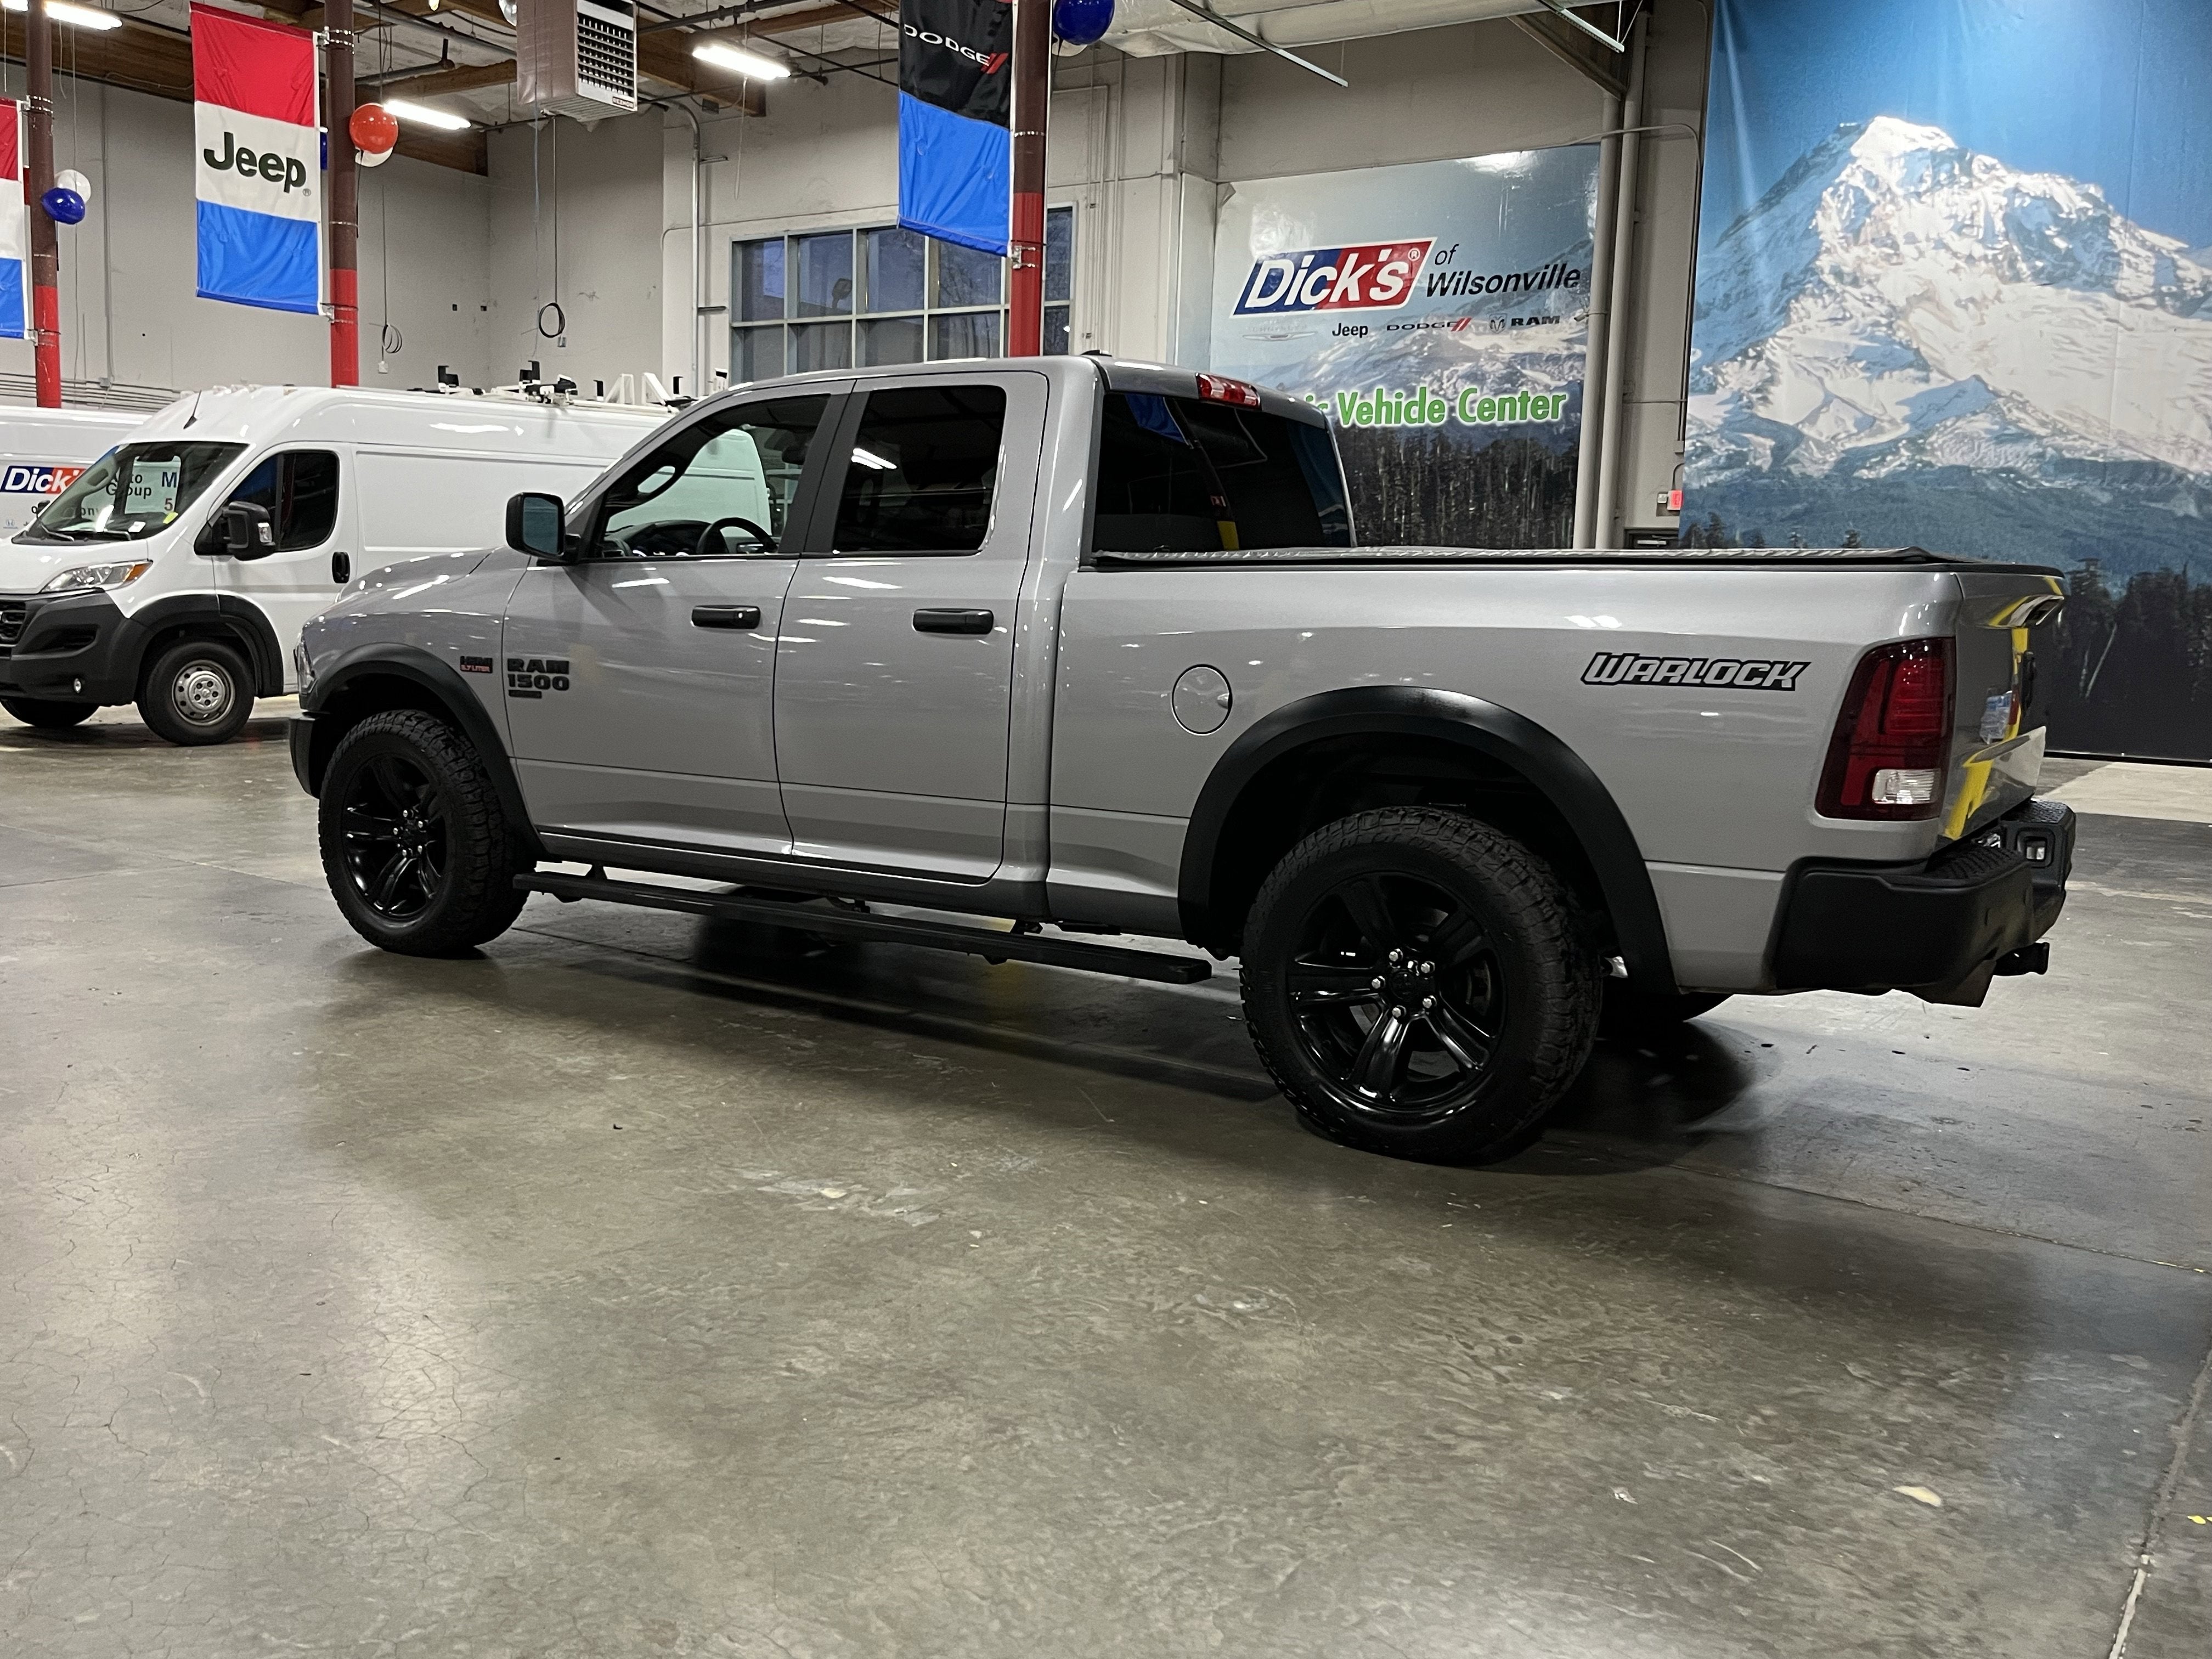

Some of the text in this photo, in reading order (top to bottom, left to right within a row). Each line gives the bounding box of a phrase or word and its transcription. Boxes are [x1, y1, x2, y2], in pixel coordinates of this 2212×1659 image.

[904, 24, 990, 66] DODGE
[204, 131, 307, 193] Jeep
[1435, 244, 1459, 266] of
[1426, 263, 1581, 297] Wilsonville
[1332, 323, 1369, 338] Jeep
[1511, 315, 1561, 327] RAM
[1337, 387, 1446, 425] Vehicle
[1458, 387, 1566, 423] Center
[106, 482, 152, 499] Goup
[507, 658, 569, 674] RAM
[507, 674, 569, 691] 1500
